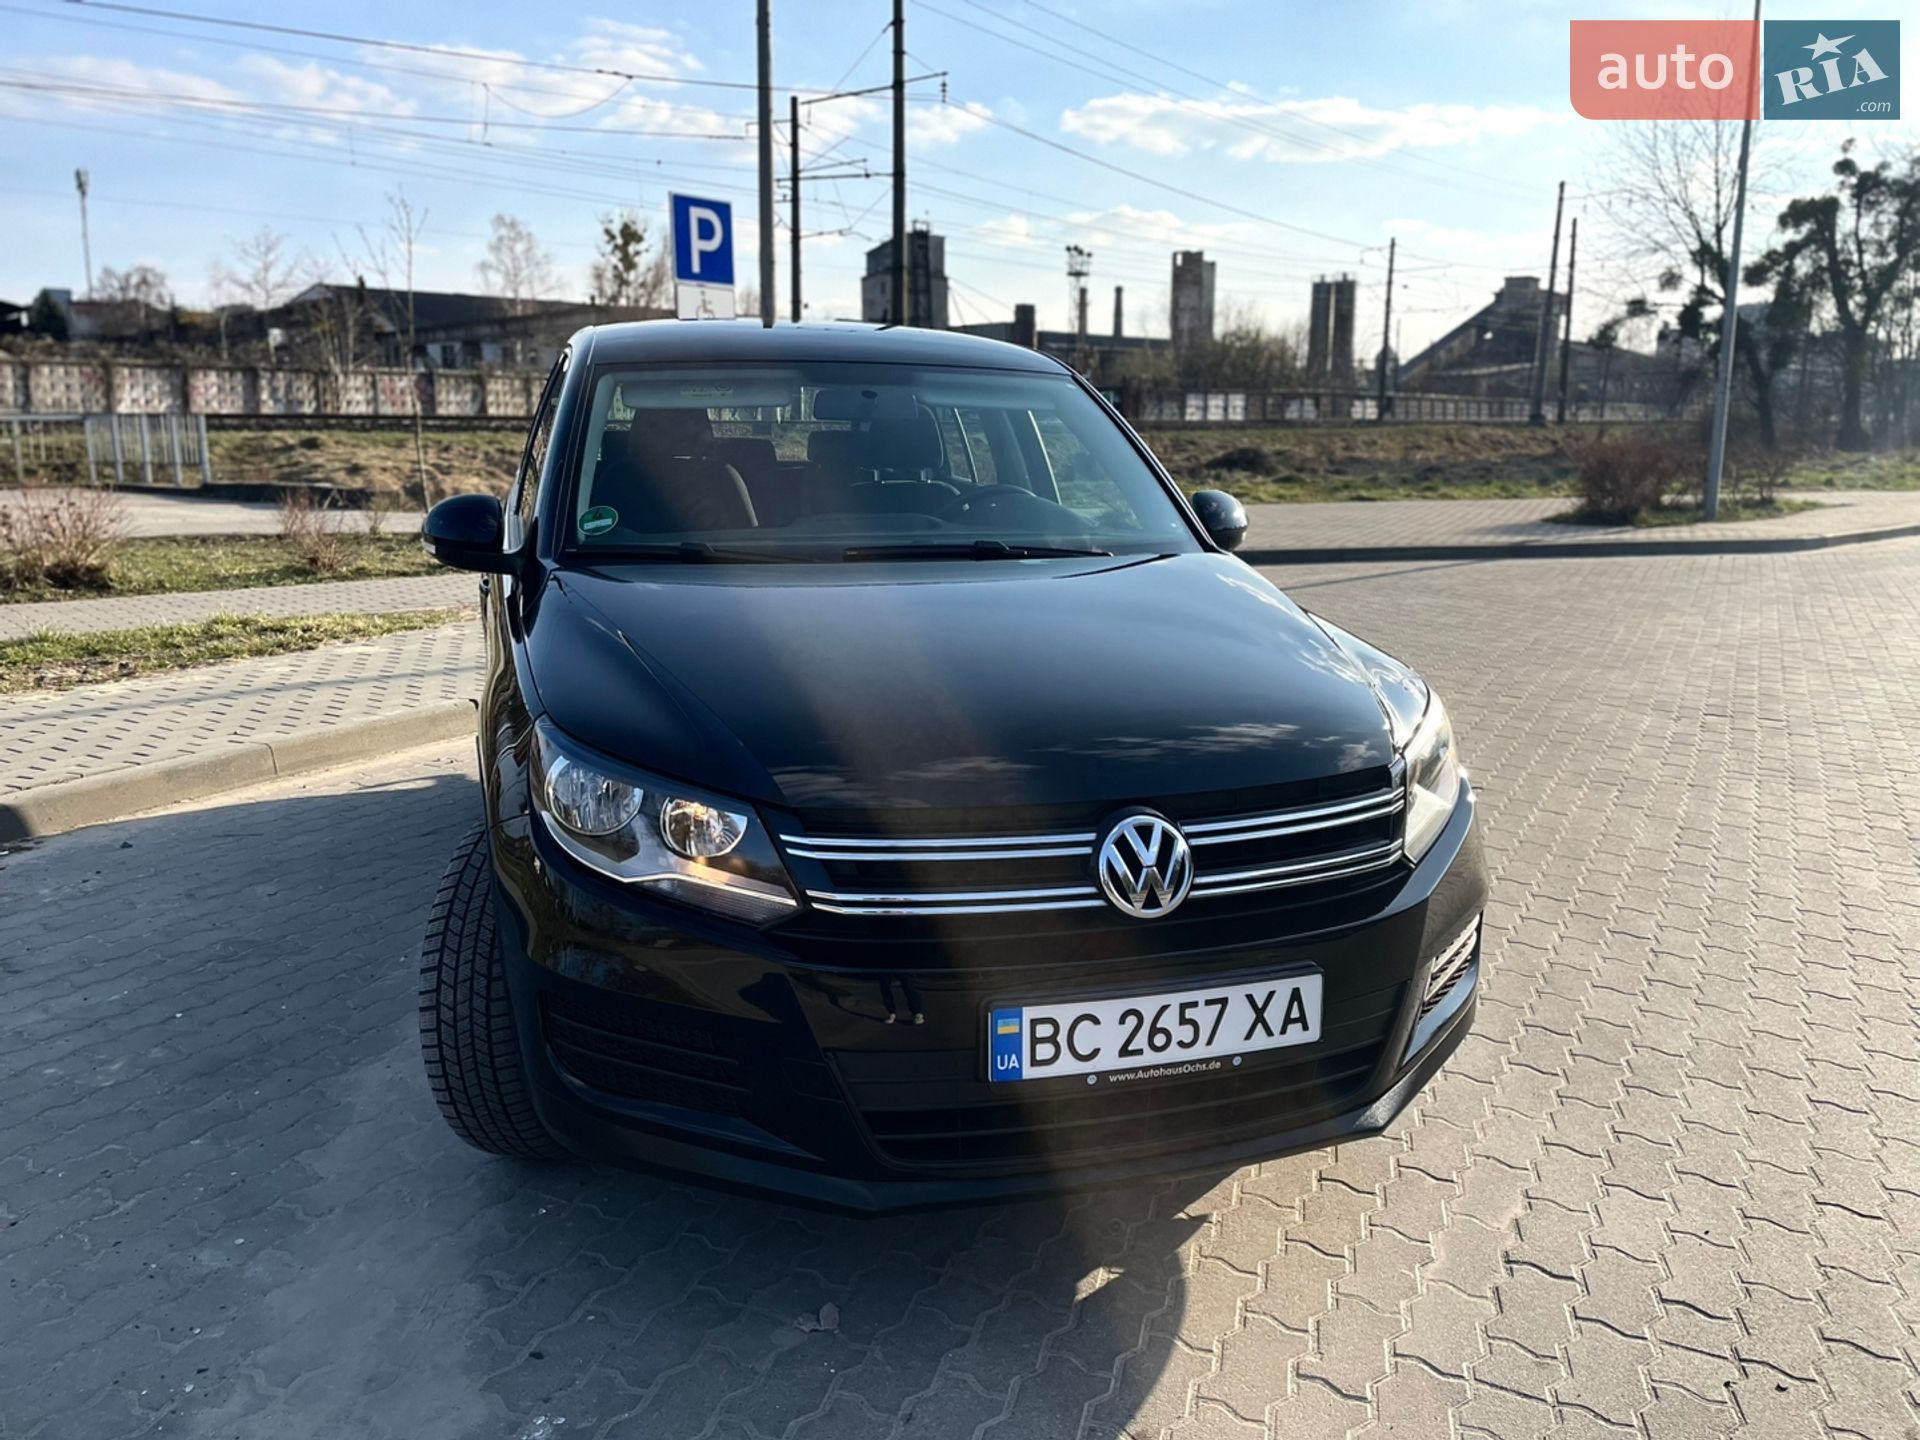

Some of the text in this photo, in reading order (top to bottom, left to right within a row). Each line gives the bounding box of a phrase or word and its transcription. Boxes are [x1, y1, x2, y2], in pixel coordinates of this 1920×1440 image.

[688, 205, 723, 274] P
[1028, 987, 1310, 1068] BC 2657 XA
[996, 1054, 1020, 1070] UA
[1109, 1060, 1222, 1082] www.AutohausOchs.de
